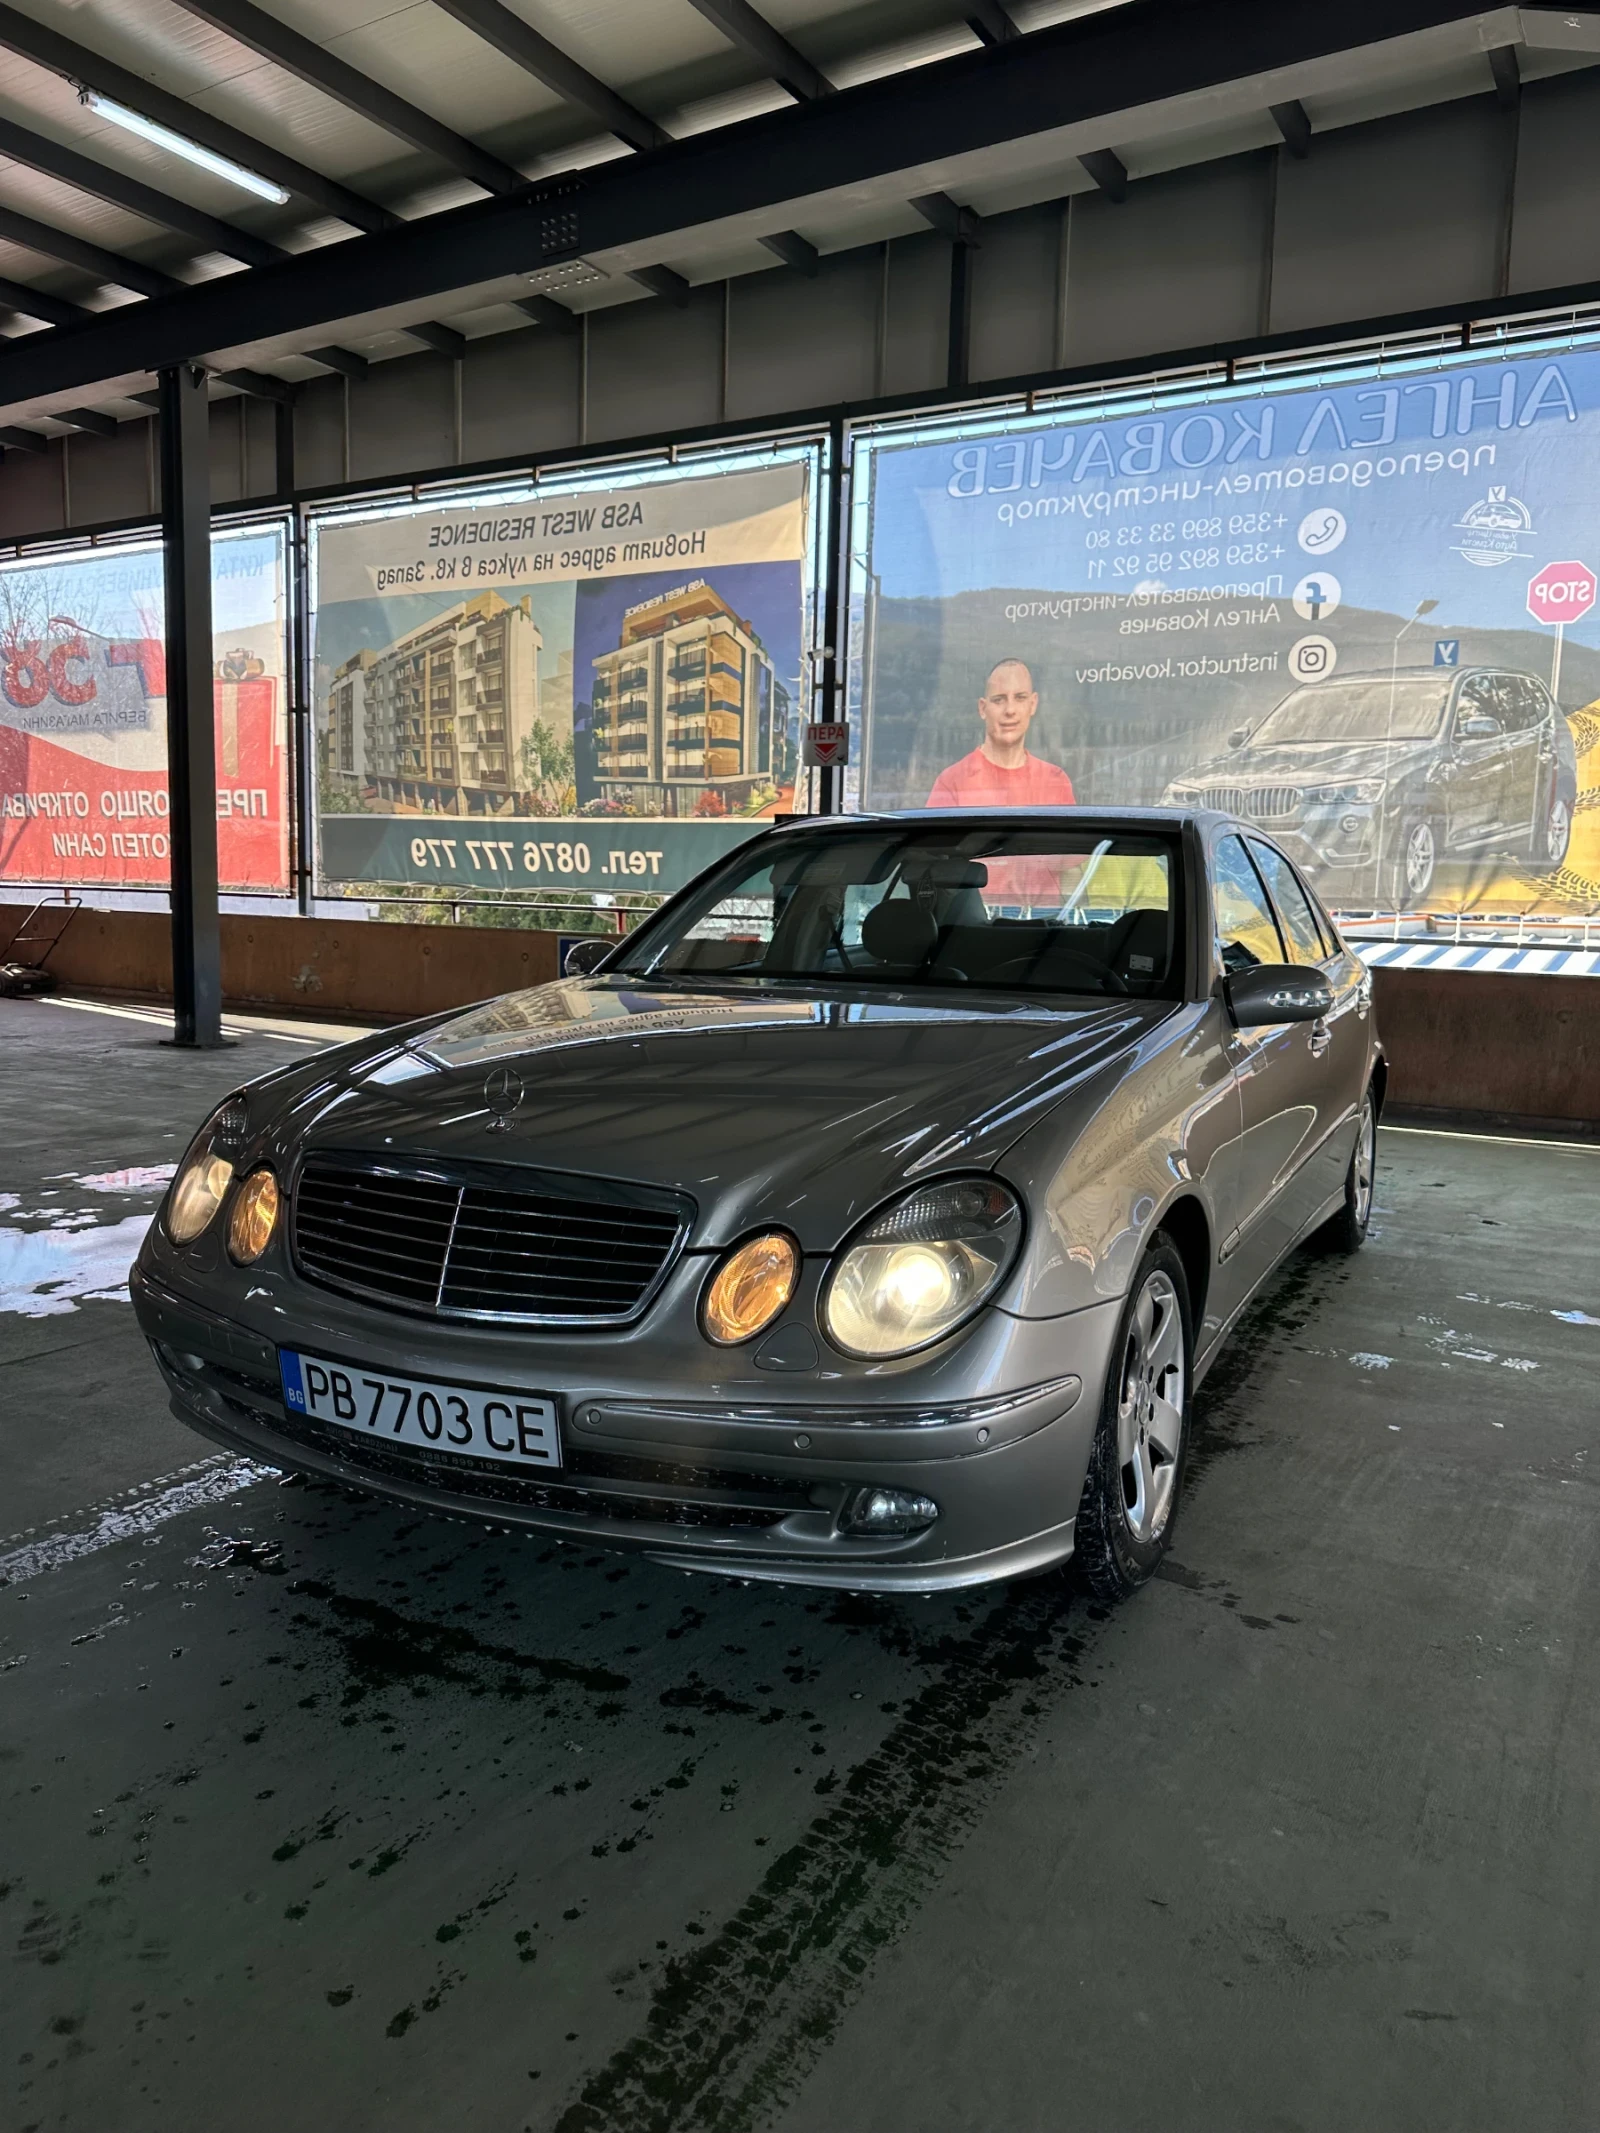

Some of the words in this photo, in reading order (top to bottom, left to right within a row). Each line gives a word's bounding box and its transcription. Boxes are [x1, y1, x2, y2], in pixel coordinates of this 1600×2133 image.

[807, 726, 845, 741] ПЕРА
[287, 1387, 304, 1405] BG
[305, 1362, 357, 1421] PB
[362, 1378, 473, 1445] 7703
[483, 1400, 549, 1459] CE
